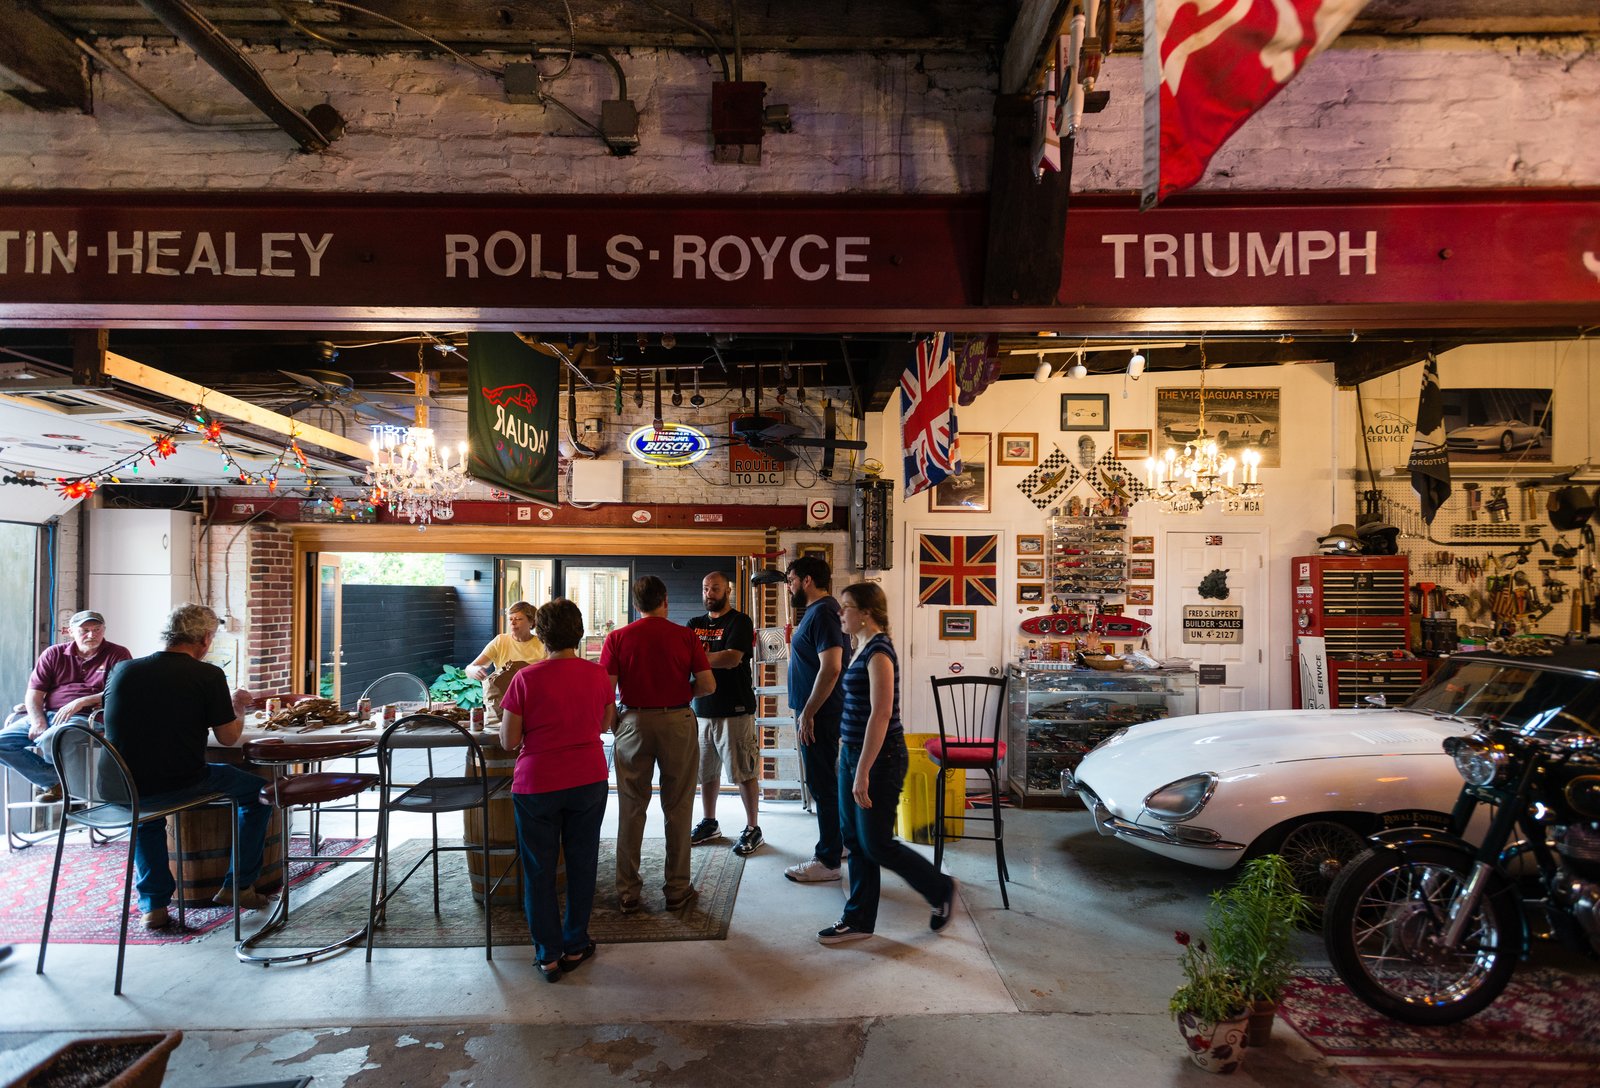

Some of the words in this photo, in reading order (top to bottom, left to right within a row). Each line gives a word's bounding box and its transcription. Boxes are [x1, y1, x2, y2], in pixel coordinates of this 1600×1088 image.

[1102, 230, 1377, 279] TRIUMPH
[1160, 391, 1178, 400] THE
[1181, 391, 1200, 400] V-12
[1203, 391, 1244, 400] JAGUAR
[1246, 391, 1279, 400] S-TYPE
[1363, 424, 1409, 435] AGUAR
[1367, 435, 1405, 443] SERVICE
[643, 441, 694, 451] BUSCH
[735, 460, 778, 471] ROUTE
[736, 473, 752, 484] TO
[758, 473, 779, 484] D.C.
[1170, 501, 1201, 512] AGUA
[1228, 502, 1239, 511] 59
[1244, 501, 1260, 512] MGA
[1188, 610, 1203, 618] FRED
[1204, 610, 1211, 618] S.
[1211, 610, 1239, 618] LIPPERT
[1315, 654, 1324, 695] SERVICE
[1383, 813, 1412, 825] ROYAL
